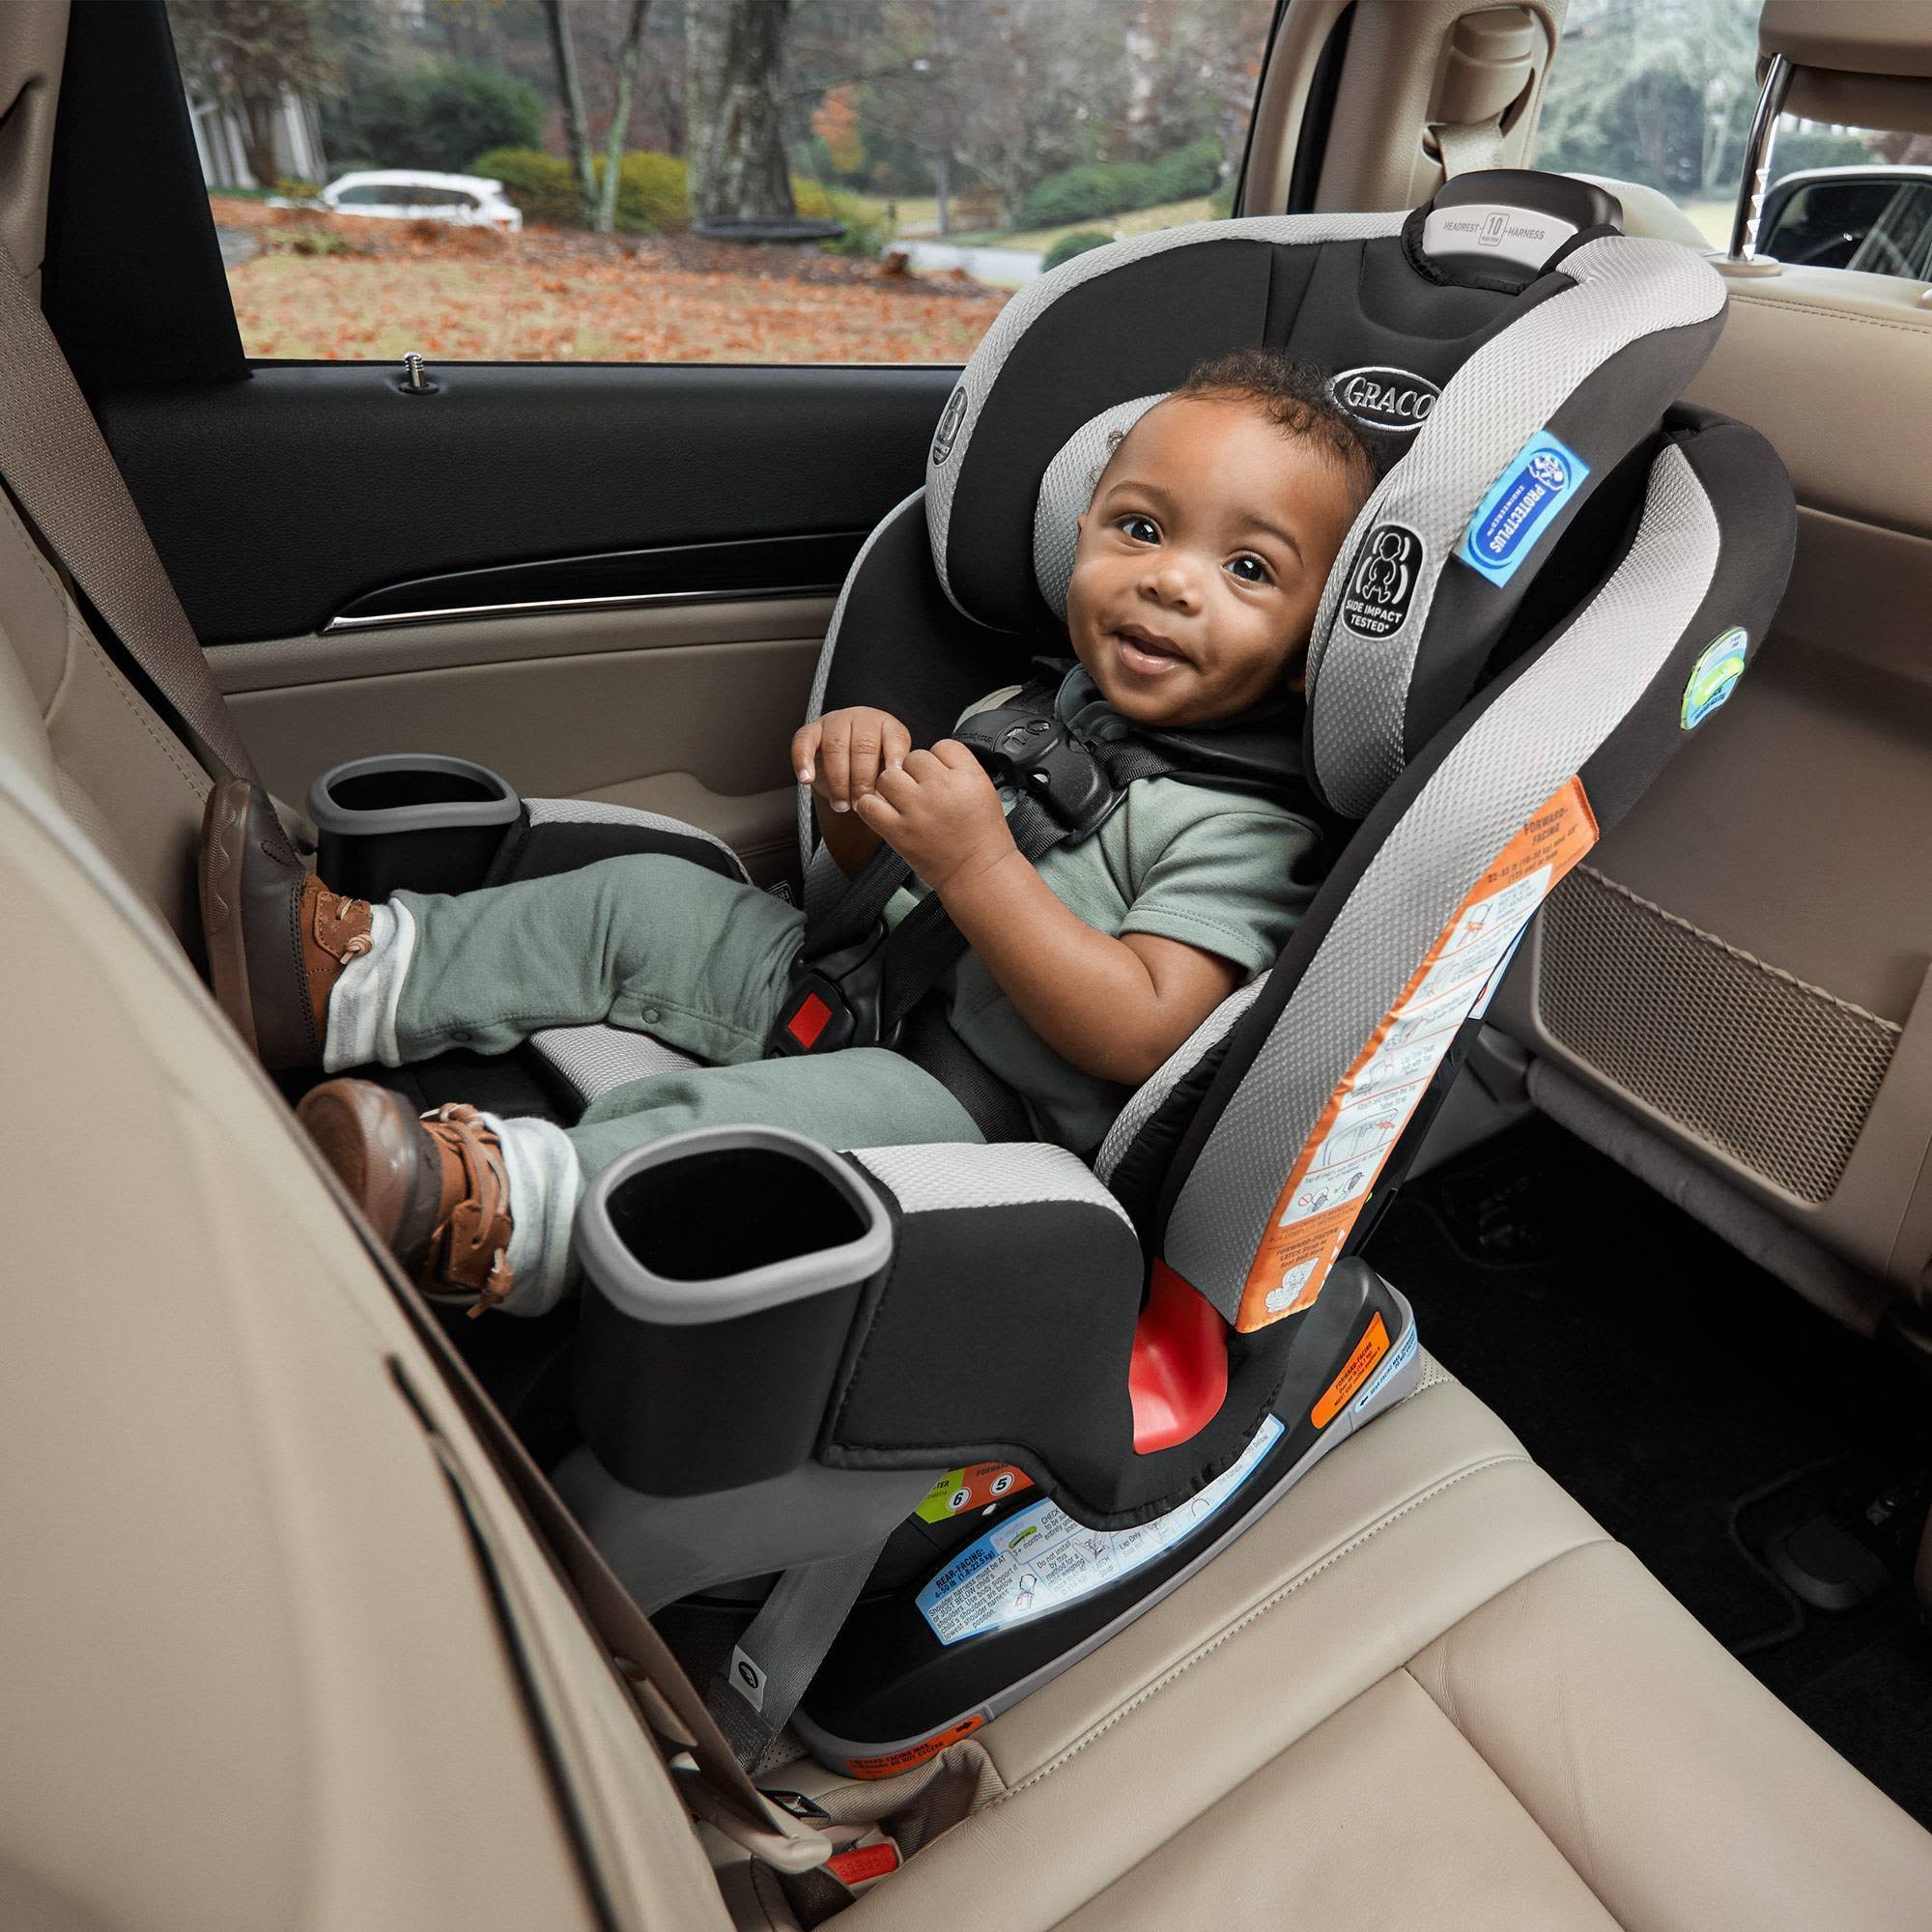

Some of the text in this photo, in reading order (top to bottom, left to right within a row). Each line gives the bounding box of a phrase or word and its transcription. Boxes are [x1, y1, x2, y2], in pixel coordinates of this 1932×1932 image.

[1487, 216, 1503, 236] 10
[1507, 227, 1546, 241] HARNESS
[1344, 376, 1436, 419] GRACO
[1489, 483, 1546, 554] PROTECTPLUS
[1345, 599, 1403, 624] SIDE IMPACT
[995, 1478, 1008, 1491] 5
[952, 1492, 964, 1506] 6
[1023, 1532, 1043, 1549] months
[1128, 1530, 1142, 1543] Only
[1037, 1540, 1071, 1569] Do not install
[1056, 1552, 1067, 1564] this
[935, 1548, 985, 1590] REAR-FACING:
[1046, 1562, 1065, 1581] method
[928, 1554, 1007, 1617] Shoulder harness must be AT
[940, 1602, 955, 1618] JUST
[954, 1586, 976, 1605] BELOW
[976, 1574, 995, 1590] child's
[965, 1596, 978, 1606] Use
[977, 1584, 992, 1598] body
[991, 1569, 1013, 1587] support
[940, 1577, 1013, 1634] child's shoulders are below
[943, 1623, 964, 1640] lowest
[963, 1605, 987, 1625] shoulder
